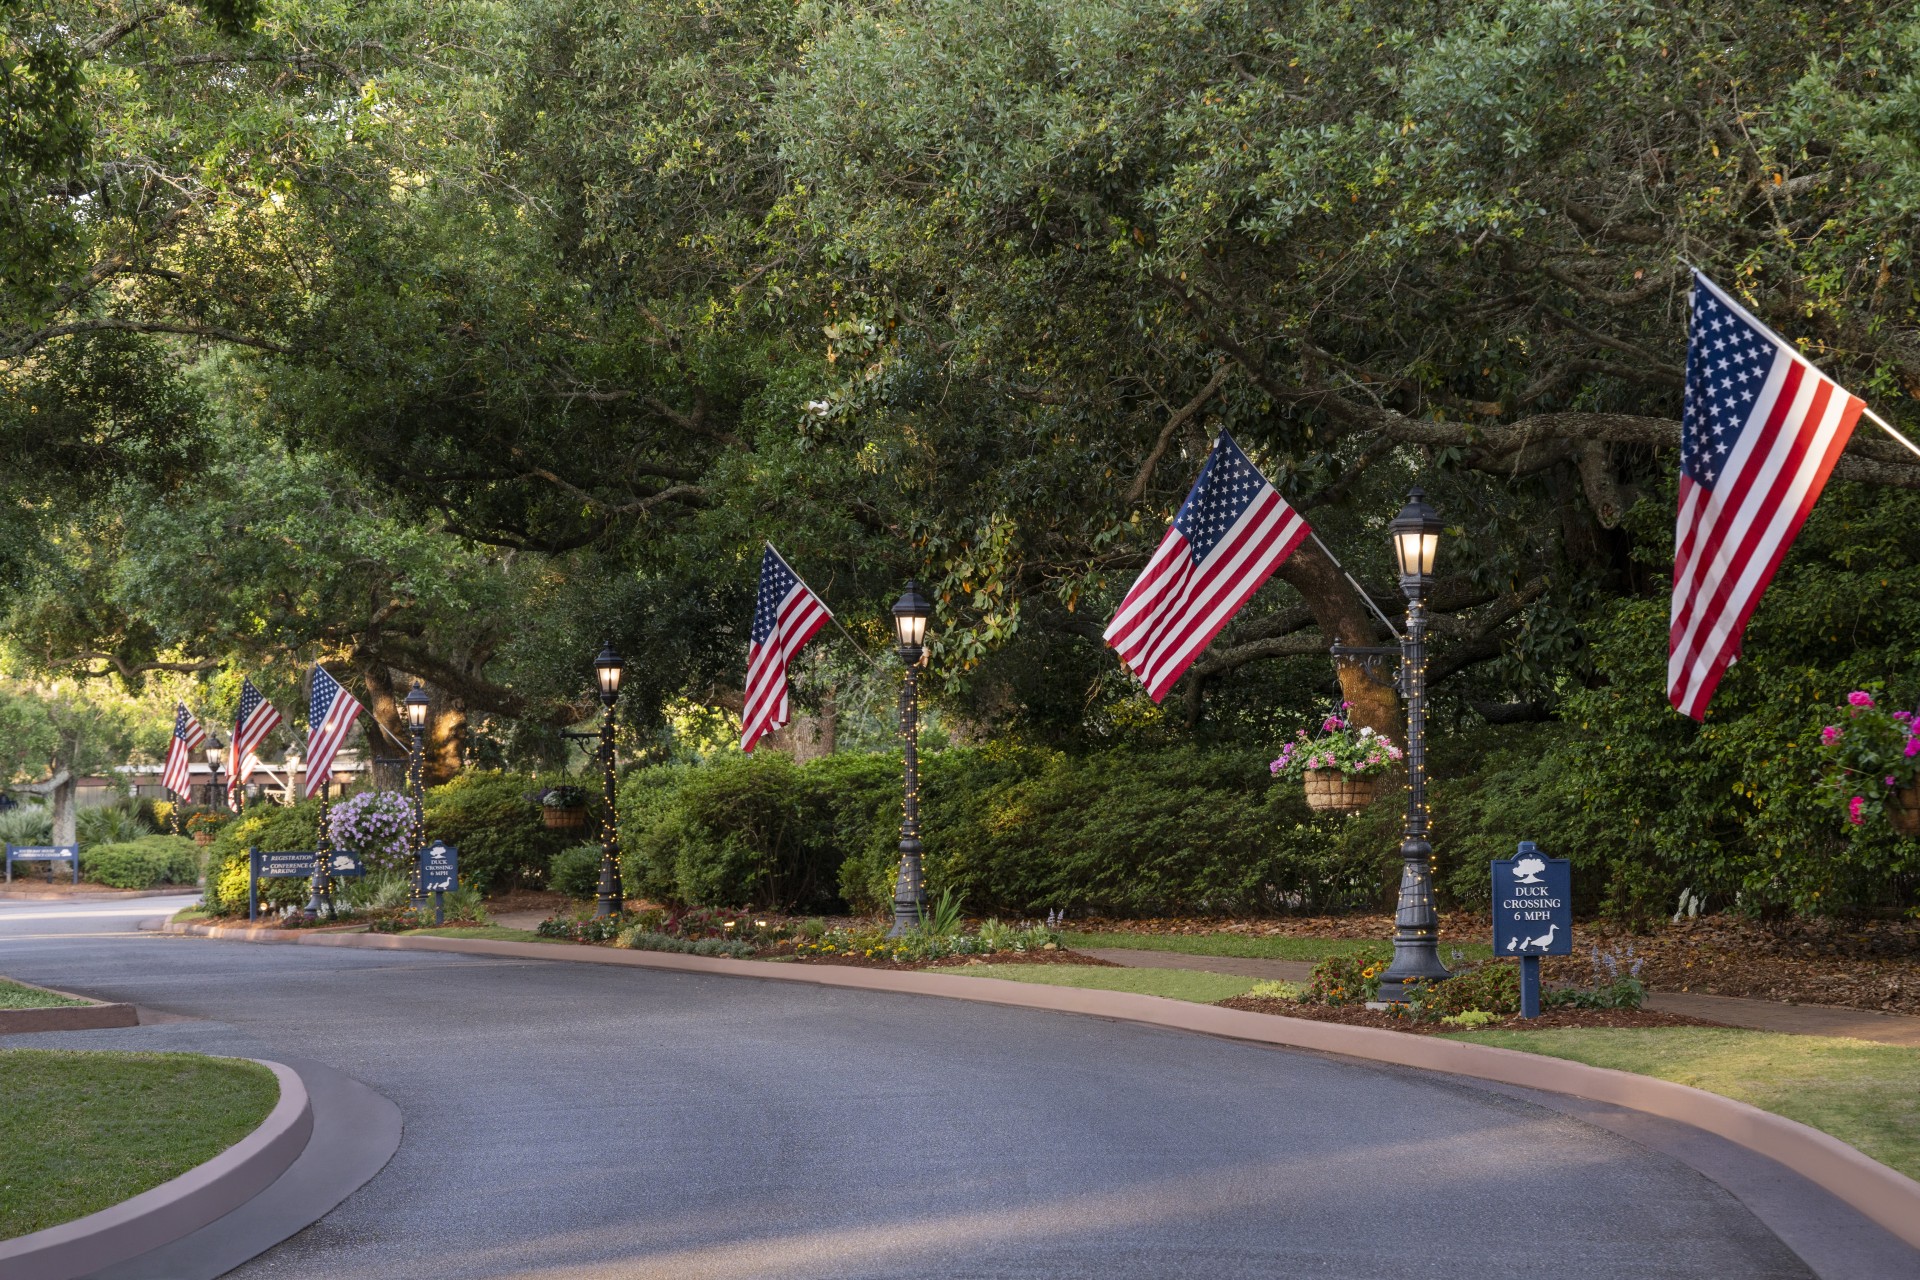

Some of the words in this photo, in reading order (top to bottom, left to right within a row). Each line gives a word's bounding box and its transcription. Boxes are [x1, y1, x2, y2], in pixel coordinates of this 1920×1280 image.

[1515, 887, 1549, 896] DUCK
[1503, 899, 1561, 908] CROSSING
[1514, 911, 1520, 920] 6
[1524, 911, 1550, 920] MPH
